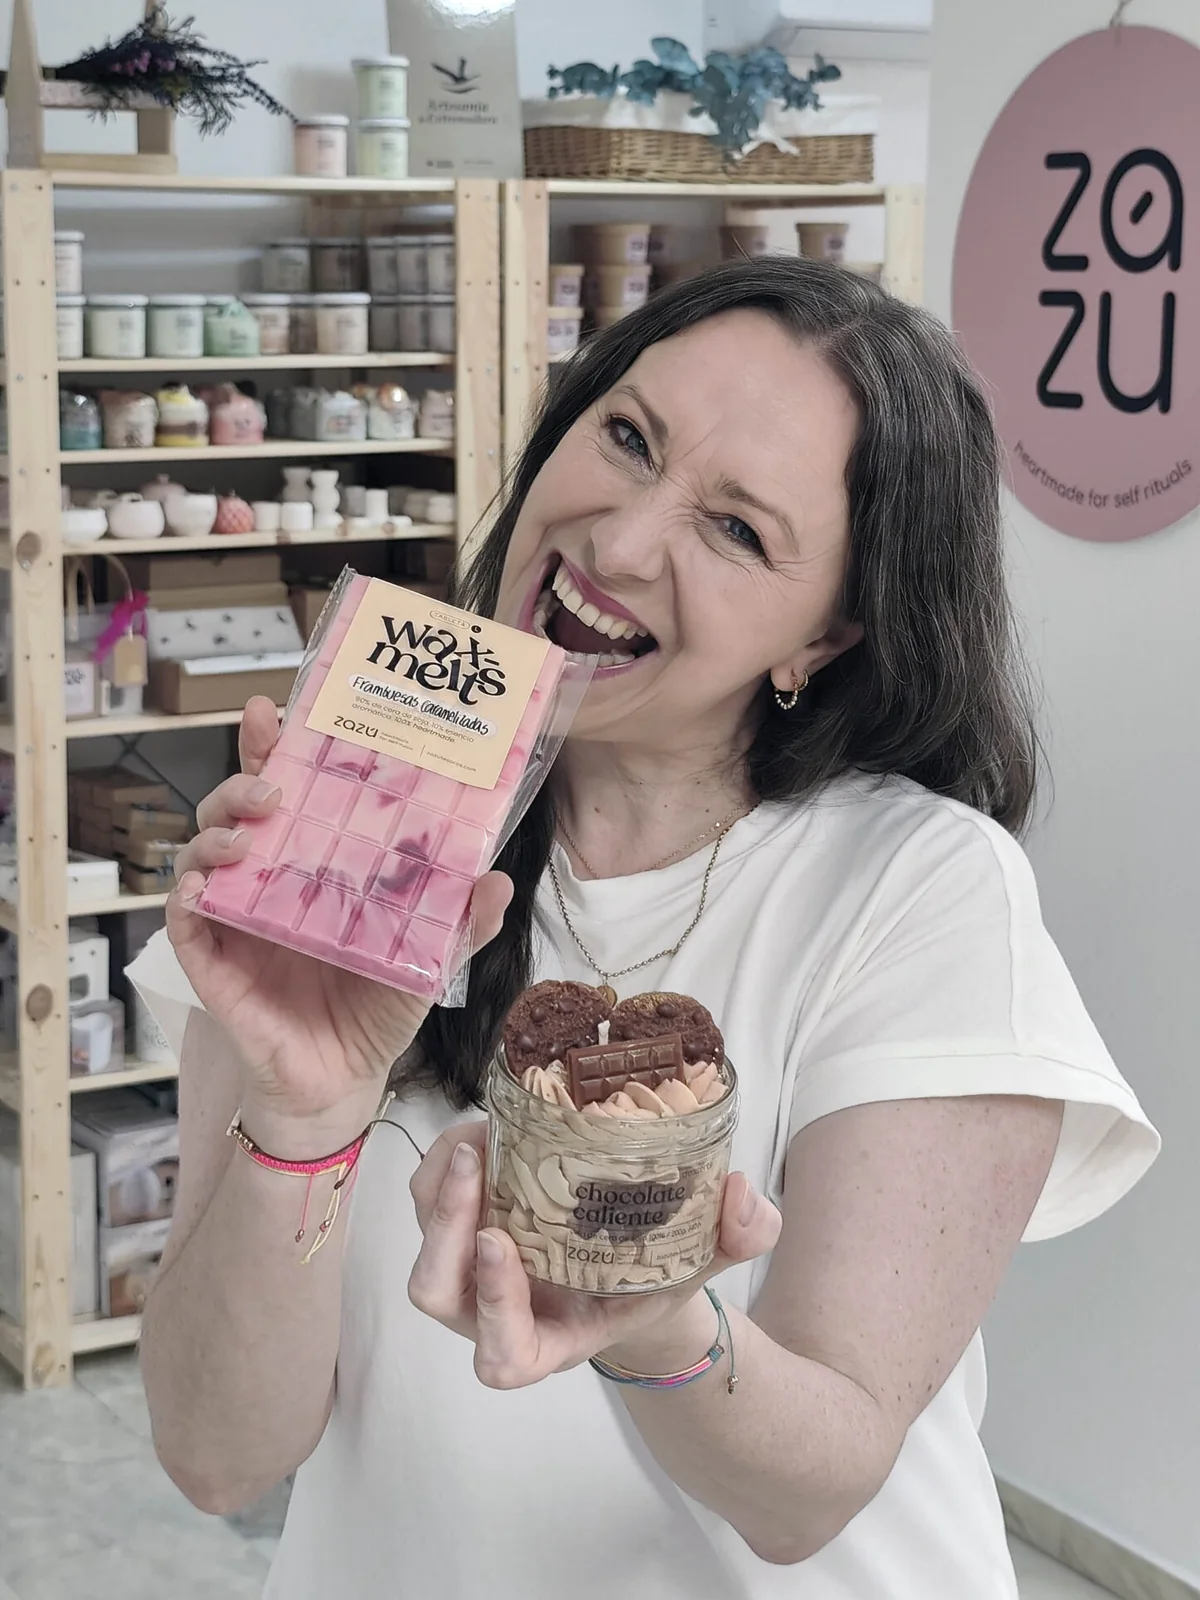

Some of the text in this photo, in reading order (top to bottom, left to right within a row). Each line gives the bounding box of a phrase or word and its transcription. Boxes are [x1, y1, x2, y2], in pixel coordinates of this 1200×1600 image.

[1014, 440, 1193, 508] heartmade for self rituals
[366, 642, 506, 705] melts
[353, 676, 489, 736] Frambuesas Caramelizadas
[372, 701, 382, 709] de
[383, 706, 402, 716] cera
[402, 711, 412, 719] de
[445, 729, 475, 743] esencia
[573, 1205, 663, 1225] caliente
[575, 1183, 685, 1204] chocolate
